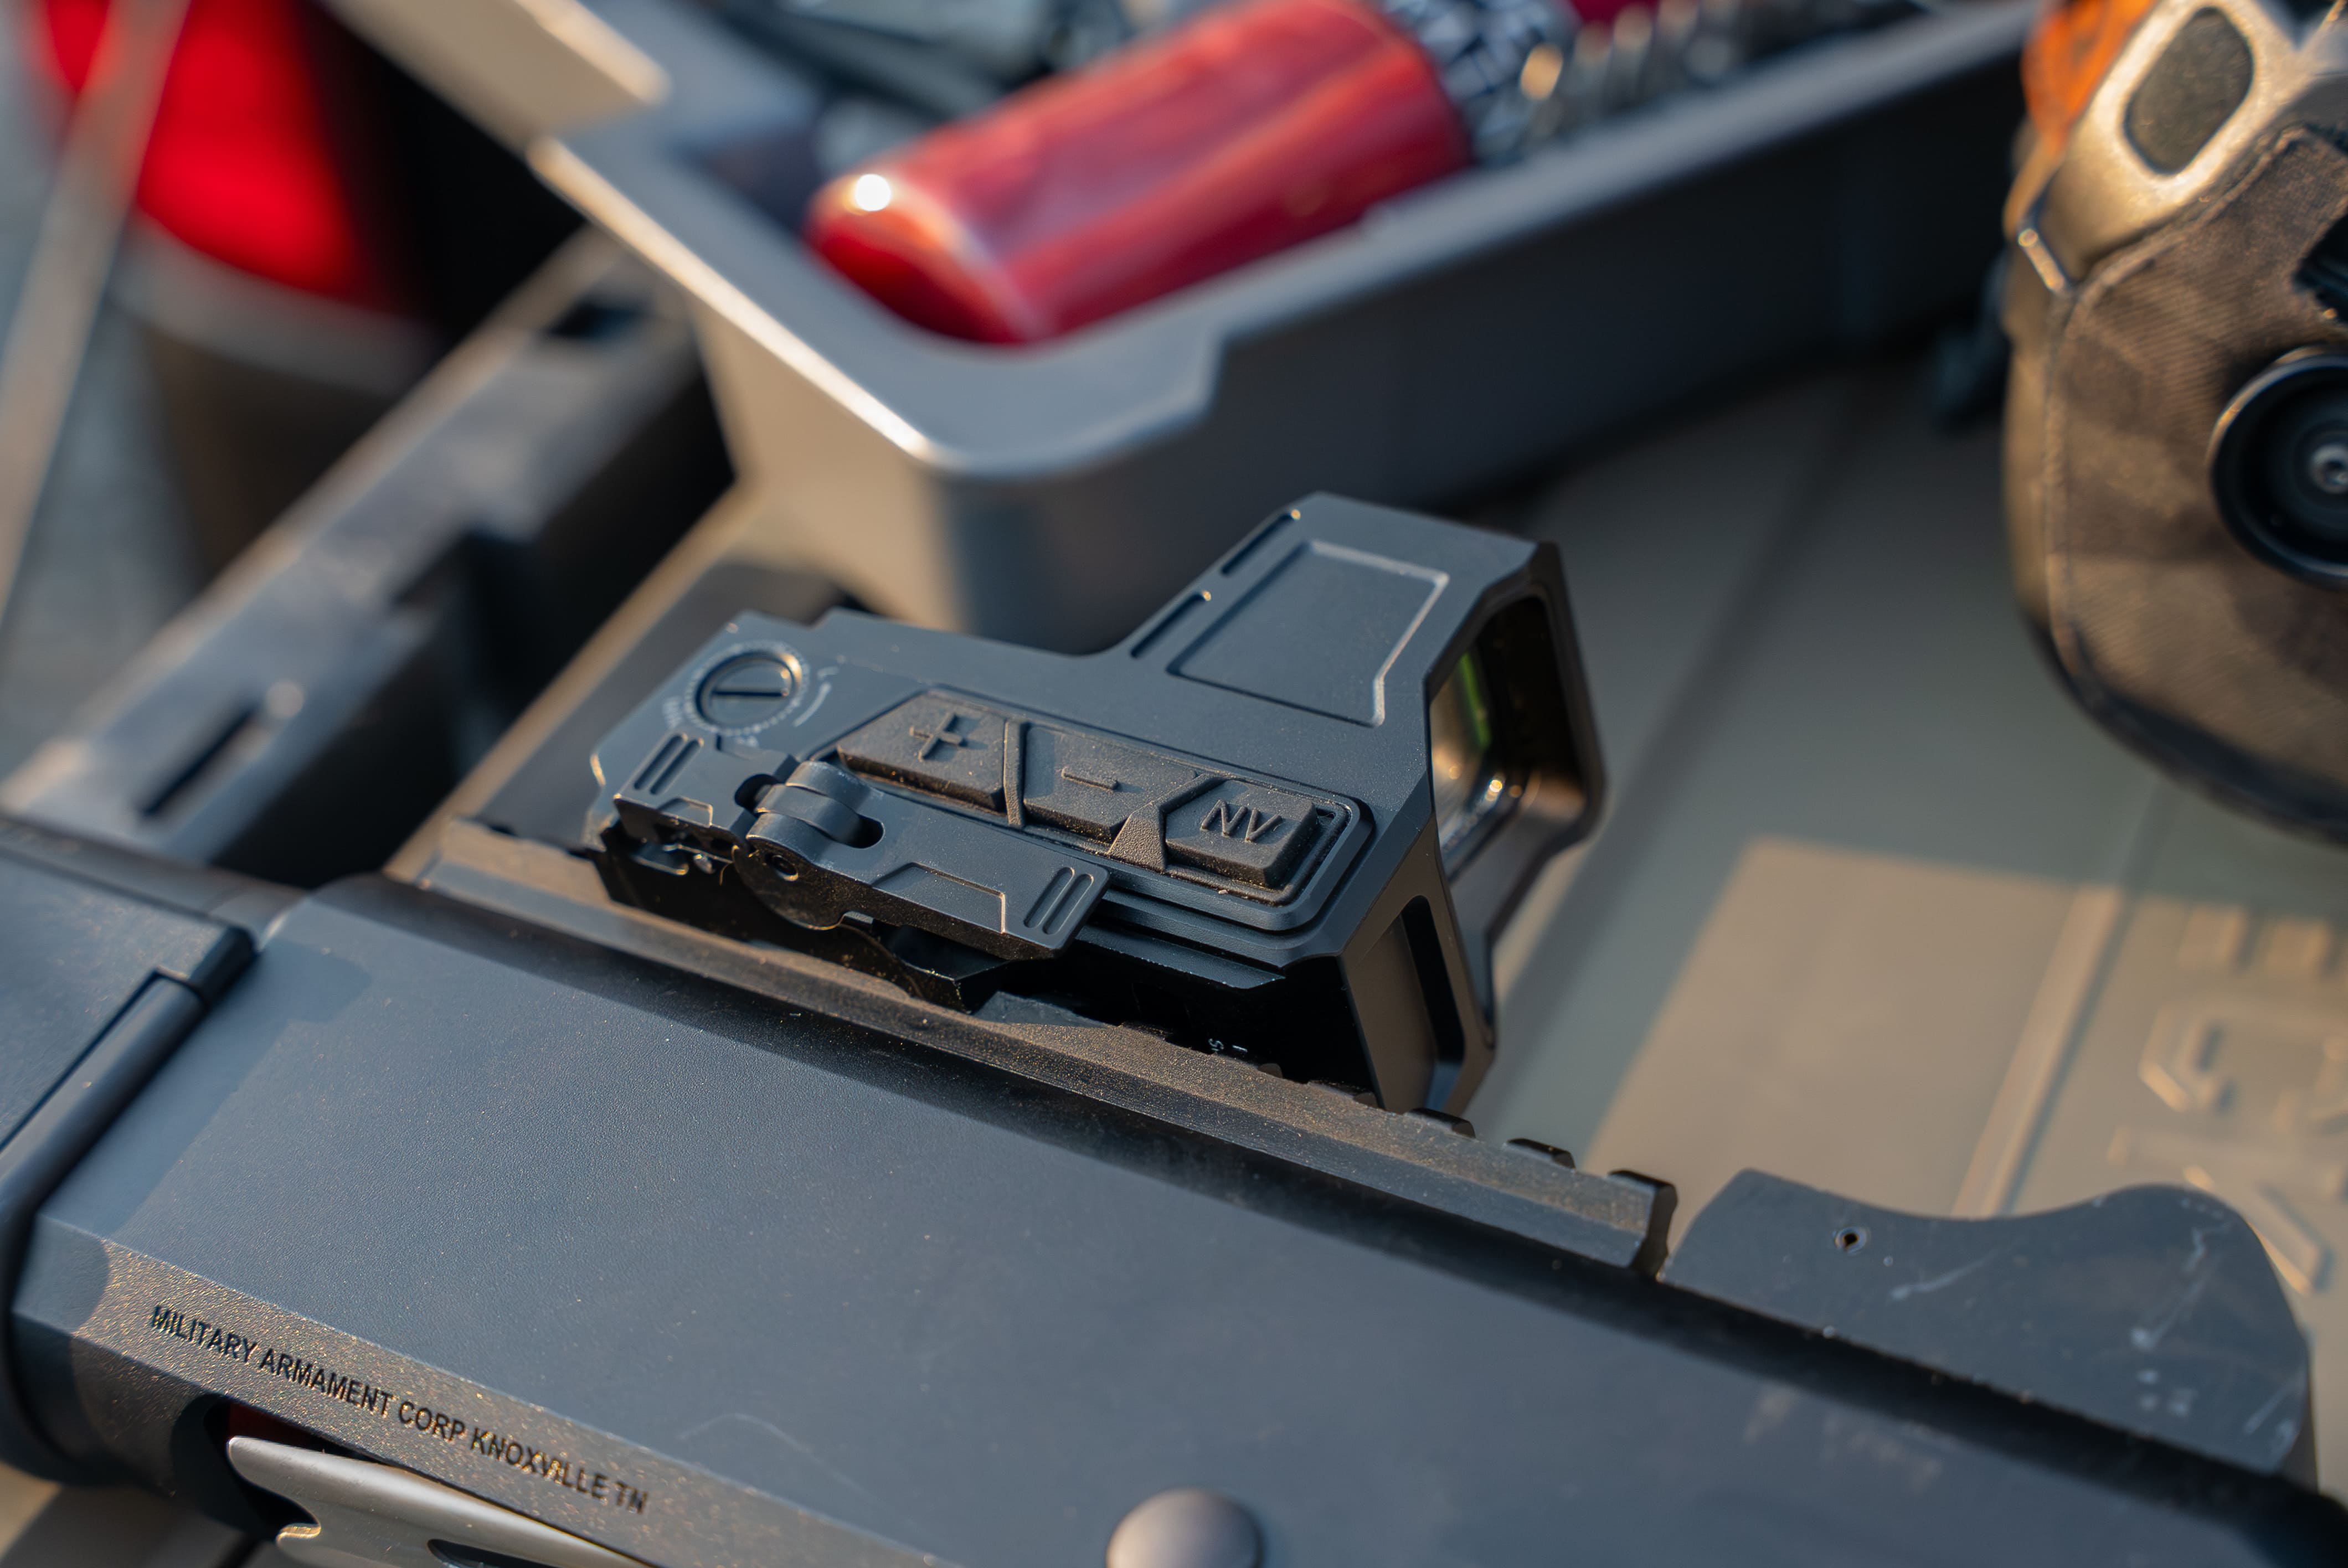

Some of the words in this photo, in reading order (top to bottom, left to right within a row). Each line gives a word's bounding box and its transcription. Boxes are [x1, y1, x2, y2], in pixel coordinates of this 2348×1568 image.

[1200, 800, 1283, 842] NV
[151, 1305, 258, 1363] MILITARY
[259, 1348, 394, 1415] ARMAMENT
[398, 1401, 465, 1441] CORP
[470, 1427, 609, 1499] KNOXVILLE
[615, 1481, 648, 1514] TN
